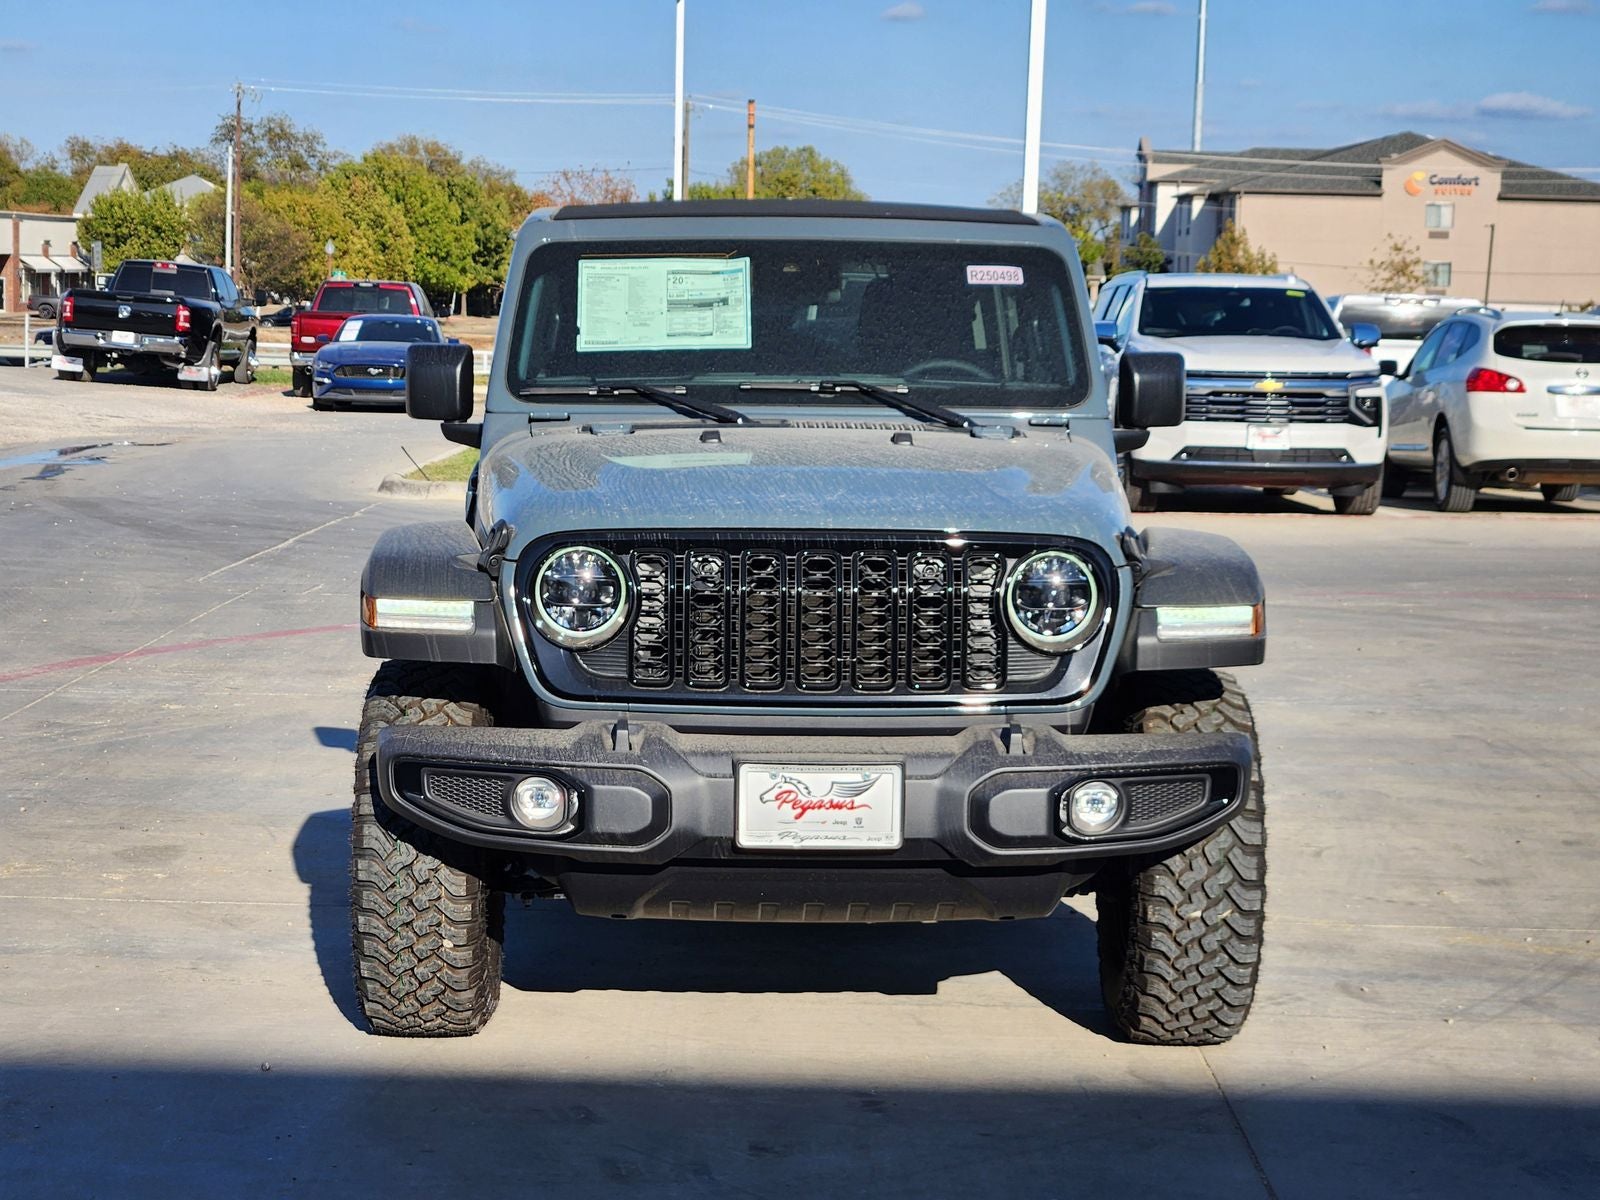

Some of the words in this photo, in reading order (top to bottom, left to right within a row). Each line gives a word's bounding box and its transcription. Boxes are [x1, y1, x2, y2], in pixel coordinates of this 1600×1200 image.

[1429, 174, 1479, 186] Comfort
[970, 270, 1019, 281] R250498
[774, 789, 872, 820] Pegasus
